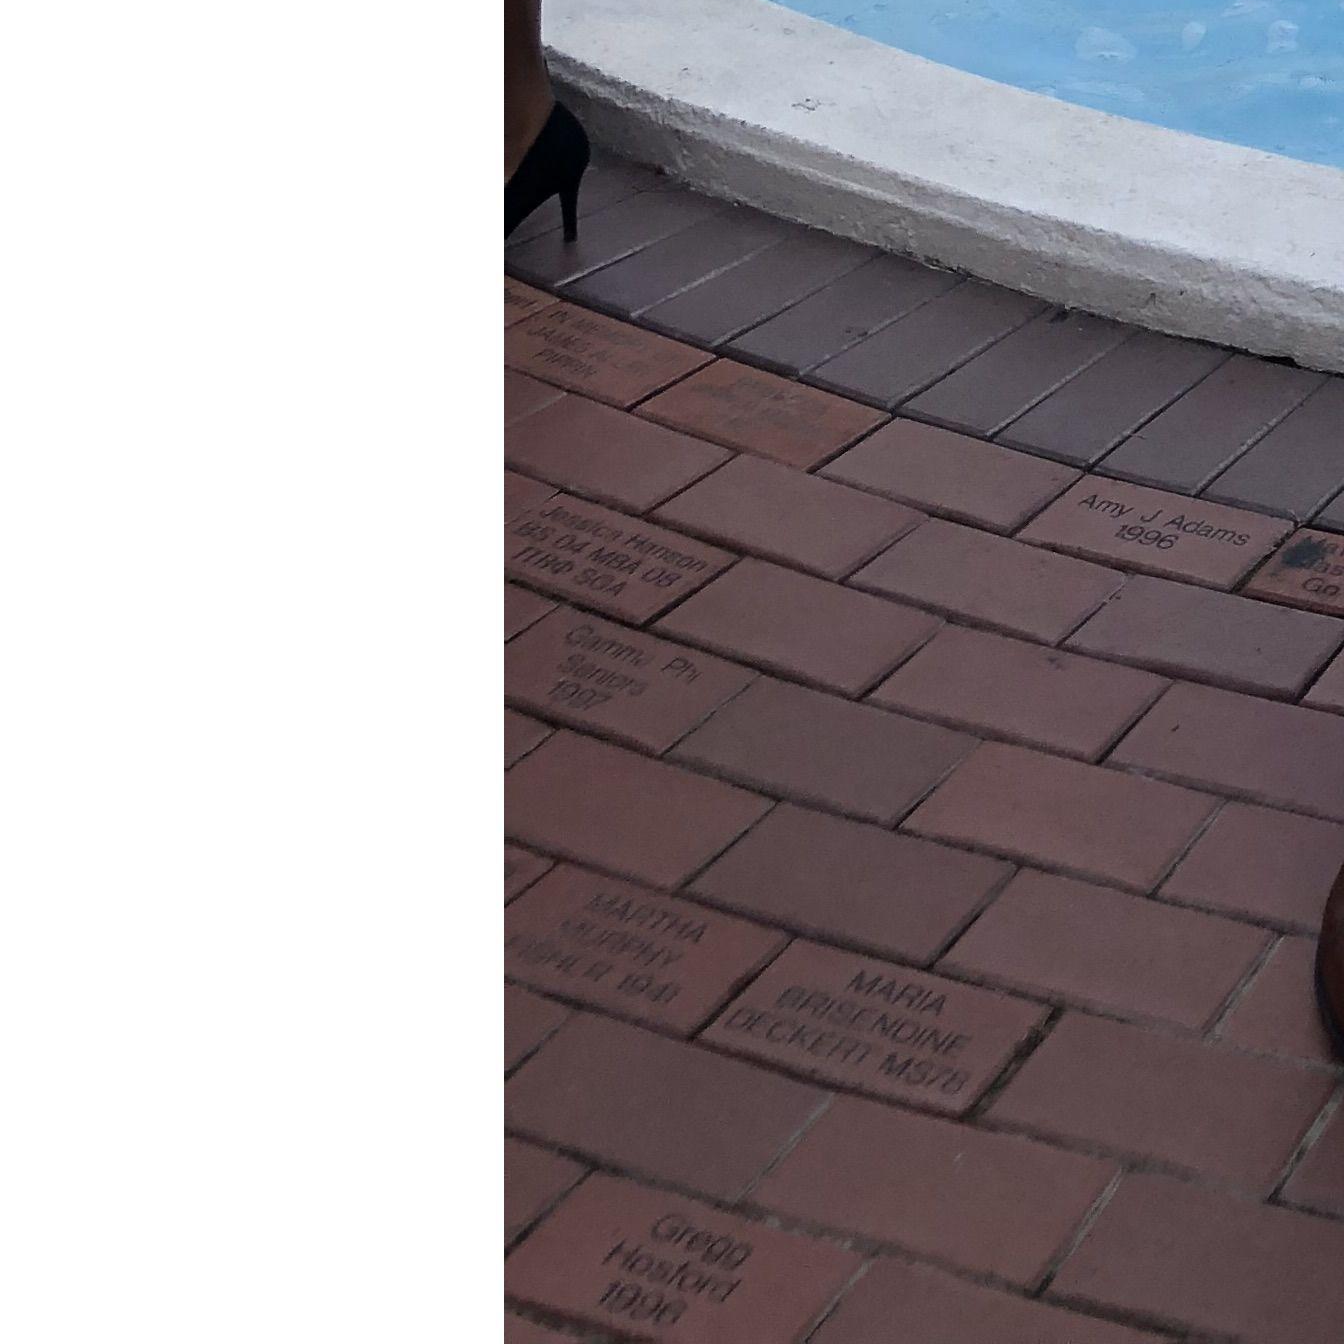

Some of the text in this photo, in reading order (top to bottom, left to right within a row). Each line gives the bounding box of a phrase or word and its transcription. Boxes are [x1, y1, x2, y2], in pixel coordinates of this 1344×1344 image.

[1077, 494, 1251, 546] Amy J Adams
[1114, 524, 1179, 551] 1996
[1302, 577, 1341, 596] Go
[846, 970, 948, 1017] MARIA
